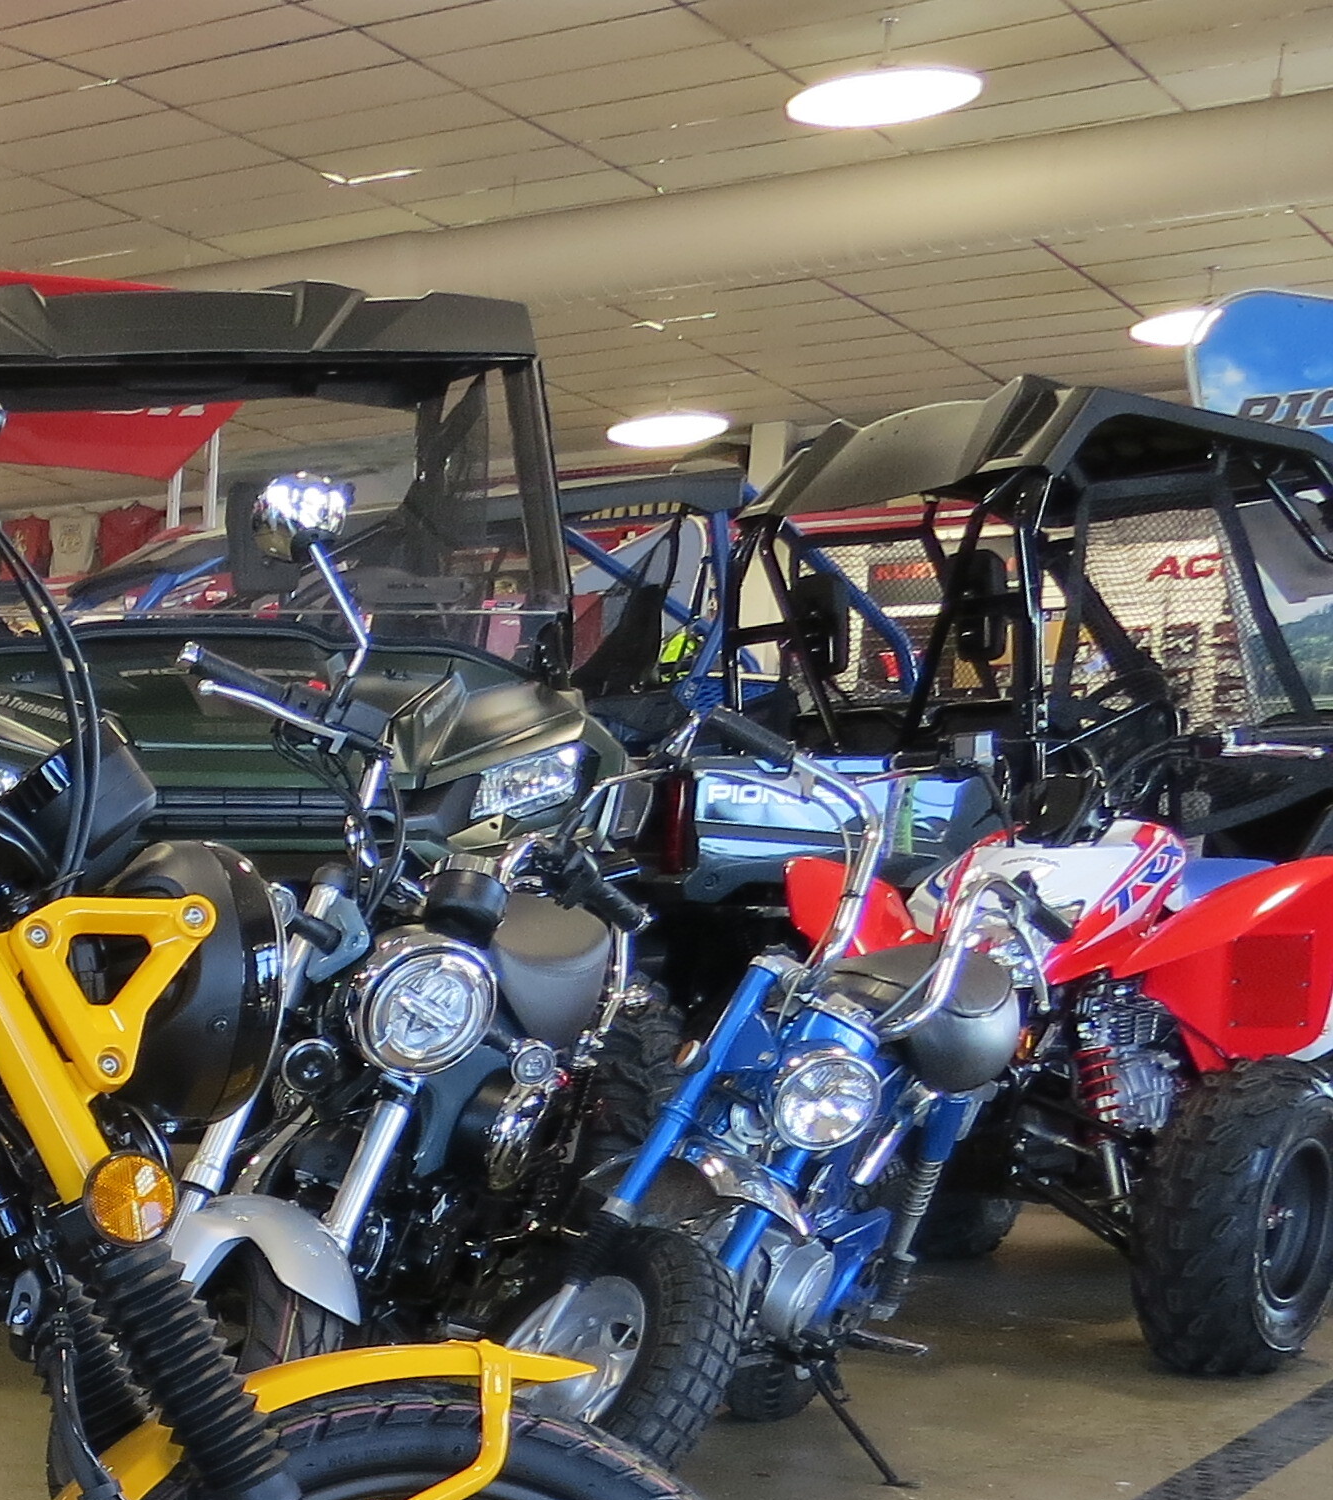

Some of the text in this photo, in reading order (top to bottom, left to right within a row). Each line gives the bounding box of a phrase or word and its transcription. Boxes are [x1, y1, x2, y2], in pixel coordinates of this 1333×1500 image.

[1146, 552, 1225, 582] AC
[9, 696, 85, 725] Transmiss
[707, 784, 845, 805] PION
